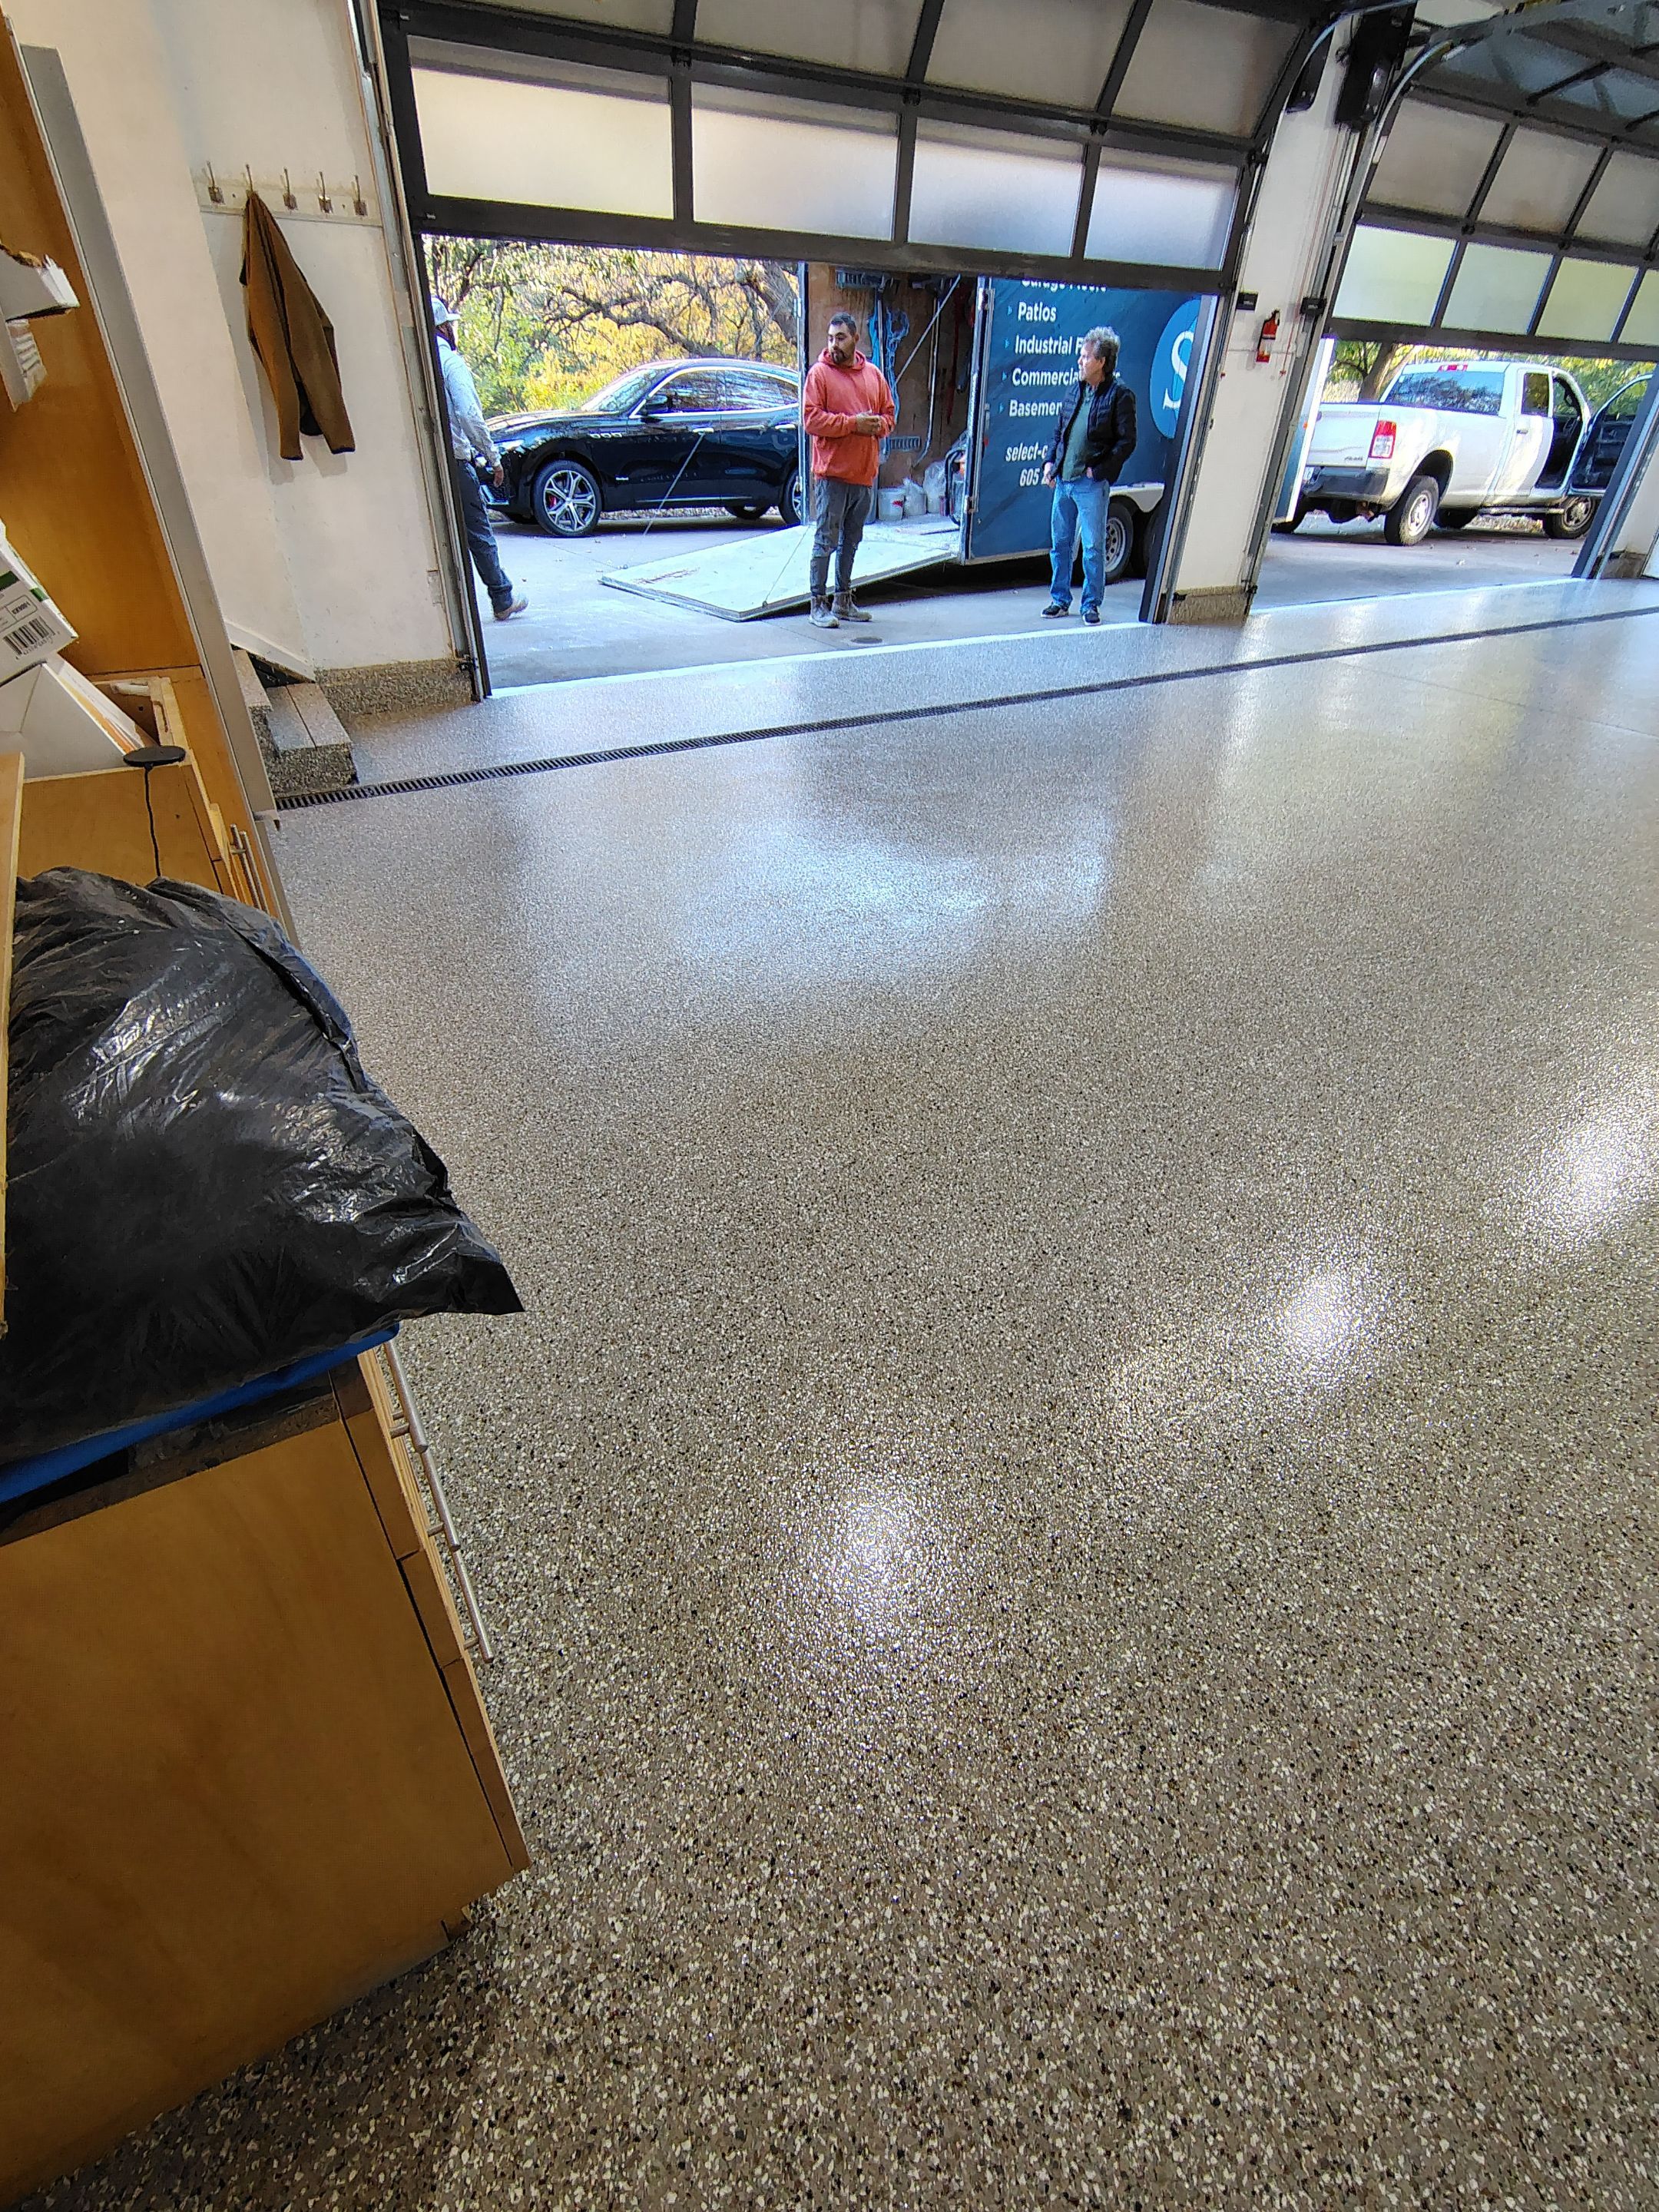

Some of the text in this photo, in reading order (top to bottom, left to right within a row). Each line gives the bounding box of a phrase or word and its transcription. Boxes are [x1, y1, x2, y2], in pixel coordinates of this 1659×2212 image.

[1018, 301, 1057, 322] Patios
[1015, 334, 1073, 355] Industrial
[1019, 467, 1041, 487] 605
